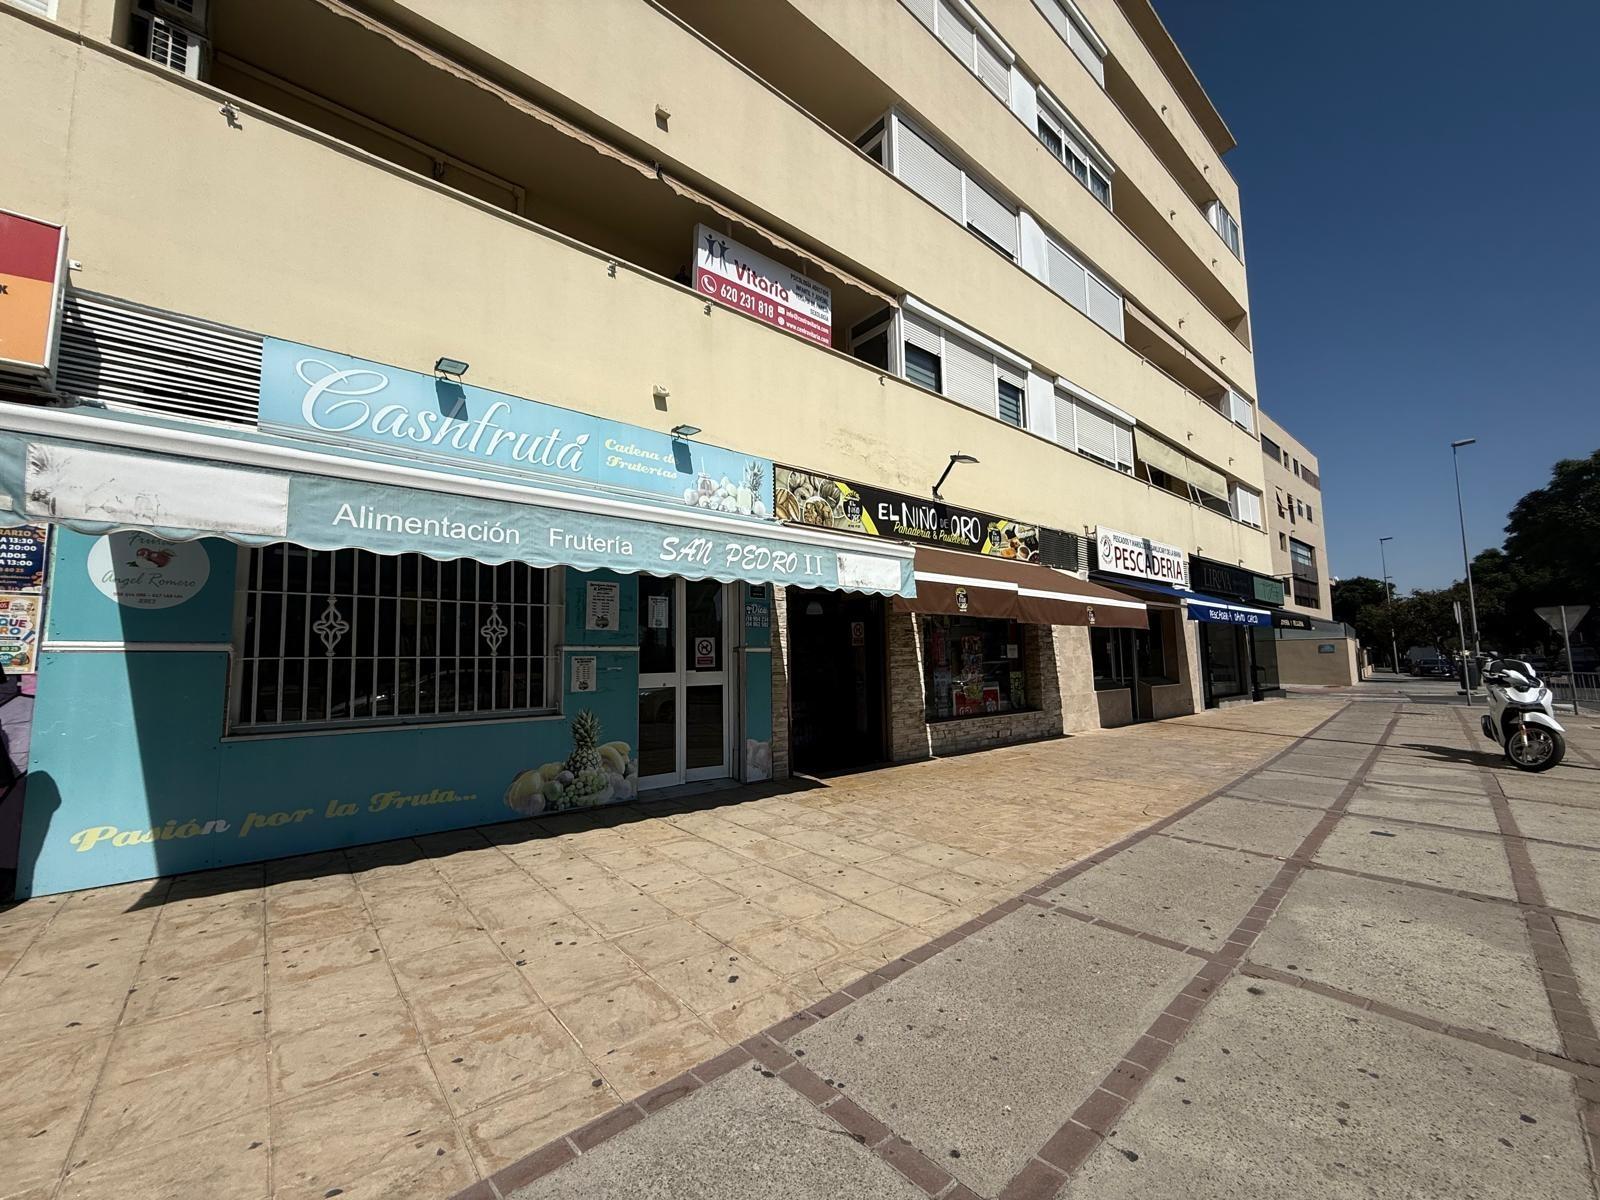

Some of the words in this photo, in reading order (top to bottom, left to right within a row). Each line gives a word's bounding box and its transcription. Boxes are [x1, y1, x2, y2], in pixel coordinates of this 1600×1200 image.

[720, 284, 737, 302] 620
[740, 292, 755, 313] 231
[758, 301, 774, 318] 818
[734, 260, 789, 302] Vitaria
[604, 438, 658, 461] Cadena
[332, 503, 520, 545] Alimentación
[878, 502, 900, 521] EL
[901, 502, 938, 530] NIÑO
[940, 518, 949, 529] DE
[950, 515, 981, 544] ORO
[932, 530, 938, 540] &
[549, 528, 633, 556] Frutería
[659, 536, 713, 565] SAN
[725, 543, 798, 574] PEDRO
[1114, 546, 1183, 580] PESCADERIA
[70, 818, 231, 853] Pasión
[238, 807, 314, 838] por
[325, 800, 360, 818] la
